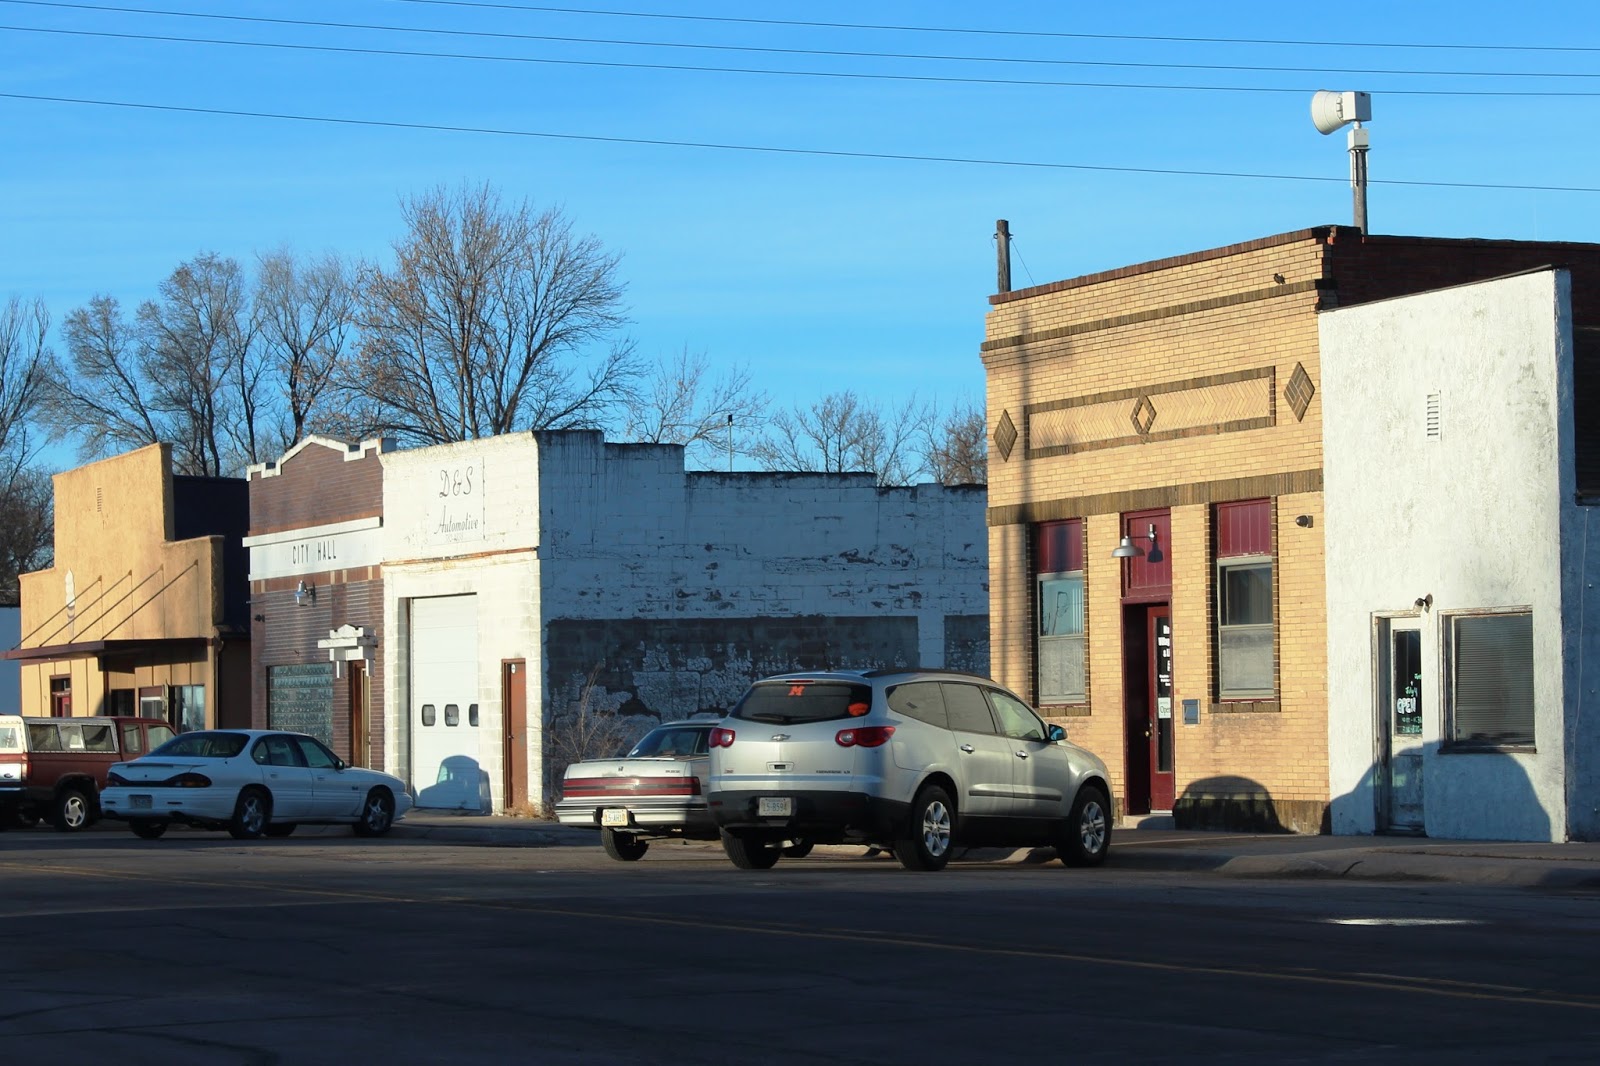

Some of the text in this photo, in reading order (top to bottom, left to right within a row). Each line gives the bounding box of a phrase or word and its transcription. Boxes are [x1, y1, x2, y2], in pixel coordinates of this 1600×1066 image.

[439, 465, 473, 498] D&S
[433, 505, 478, 535] Automotive
[292, 540, 337, 564] CITY HALL
[1160, 705, 1171, 716] Ope
[1396, 697, 1416, 714] OPEN
